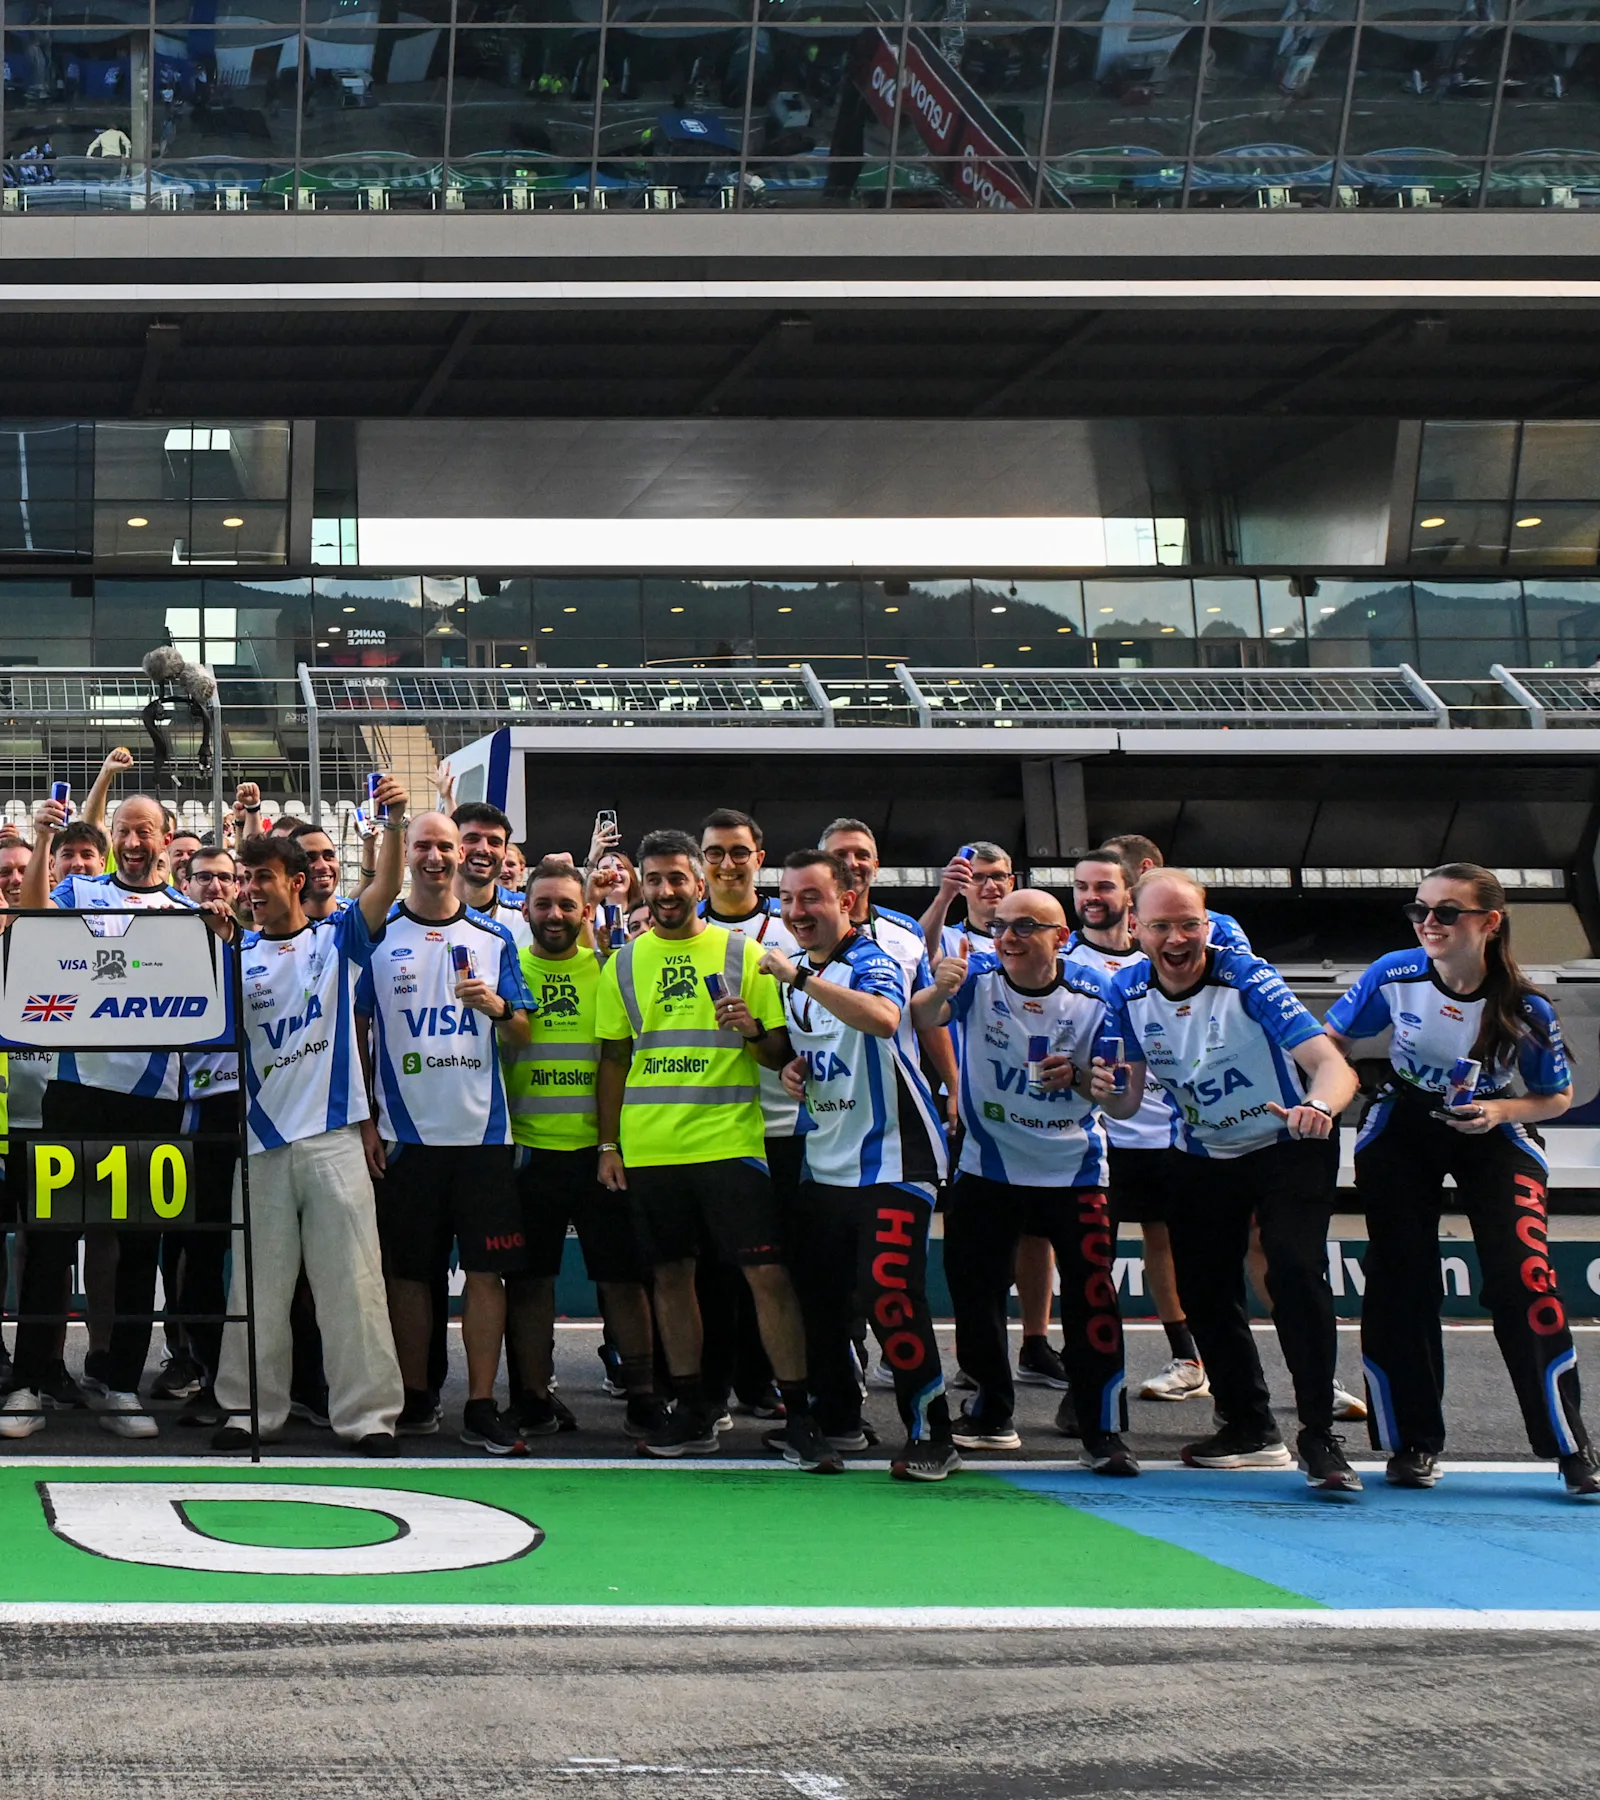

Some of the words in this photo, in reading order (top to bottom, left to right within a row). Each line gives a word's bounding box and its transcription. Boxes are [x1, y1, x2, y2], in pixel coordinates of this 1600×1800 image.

[473, 916, 501, 932] HUGO
[887, 914, 913, 928] HUGO
[58, 960, 87, 970] VISA
[664, 955, 691, 965] VISA
[865, 959, 896, 970] VISA
[544, 974, 571, 982] VISA
[1386, 964, 1418, 978] HUGO
[394, 985, 417, 994] Mobil
[1072, 978, 1100, 993] HUGO
[1125, 981, 1148, 996] HUG
[248, 989, 272, 999] TUDOR
[90, 996, 208, 1018] ARVID
[252, 999, 275, 1011] Mobil
[398, 1005, 479, 1037] VISA
[1440, 1009, 1451, 1018] Red
[1451, 1013, 1464, 1022] Bull
[274, 1050, 302, 1069] Cash
[304, 1039, 329, 1055] App
[426, 1055, 459, 1068] Cash
[460, 1055, 481, 1070] App
[643, 1056, 709, 1075] Airtasker
[801, 1050, 851, 1081] ISA
[214, 1070, 238, 1081] Cas
[531, 1069, 595, 1085] Airtasker
[1010, 1113, 1043, 1128] Cash
[35, 1143, 188, 1220] P10
[1514, 1173, 1566, 1336] HUGO
[1077, 1192, 1120, 1353] HUGO
[872, 1207, 925, 1370] HUGO
